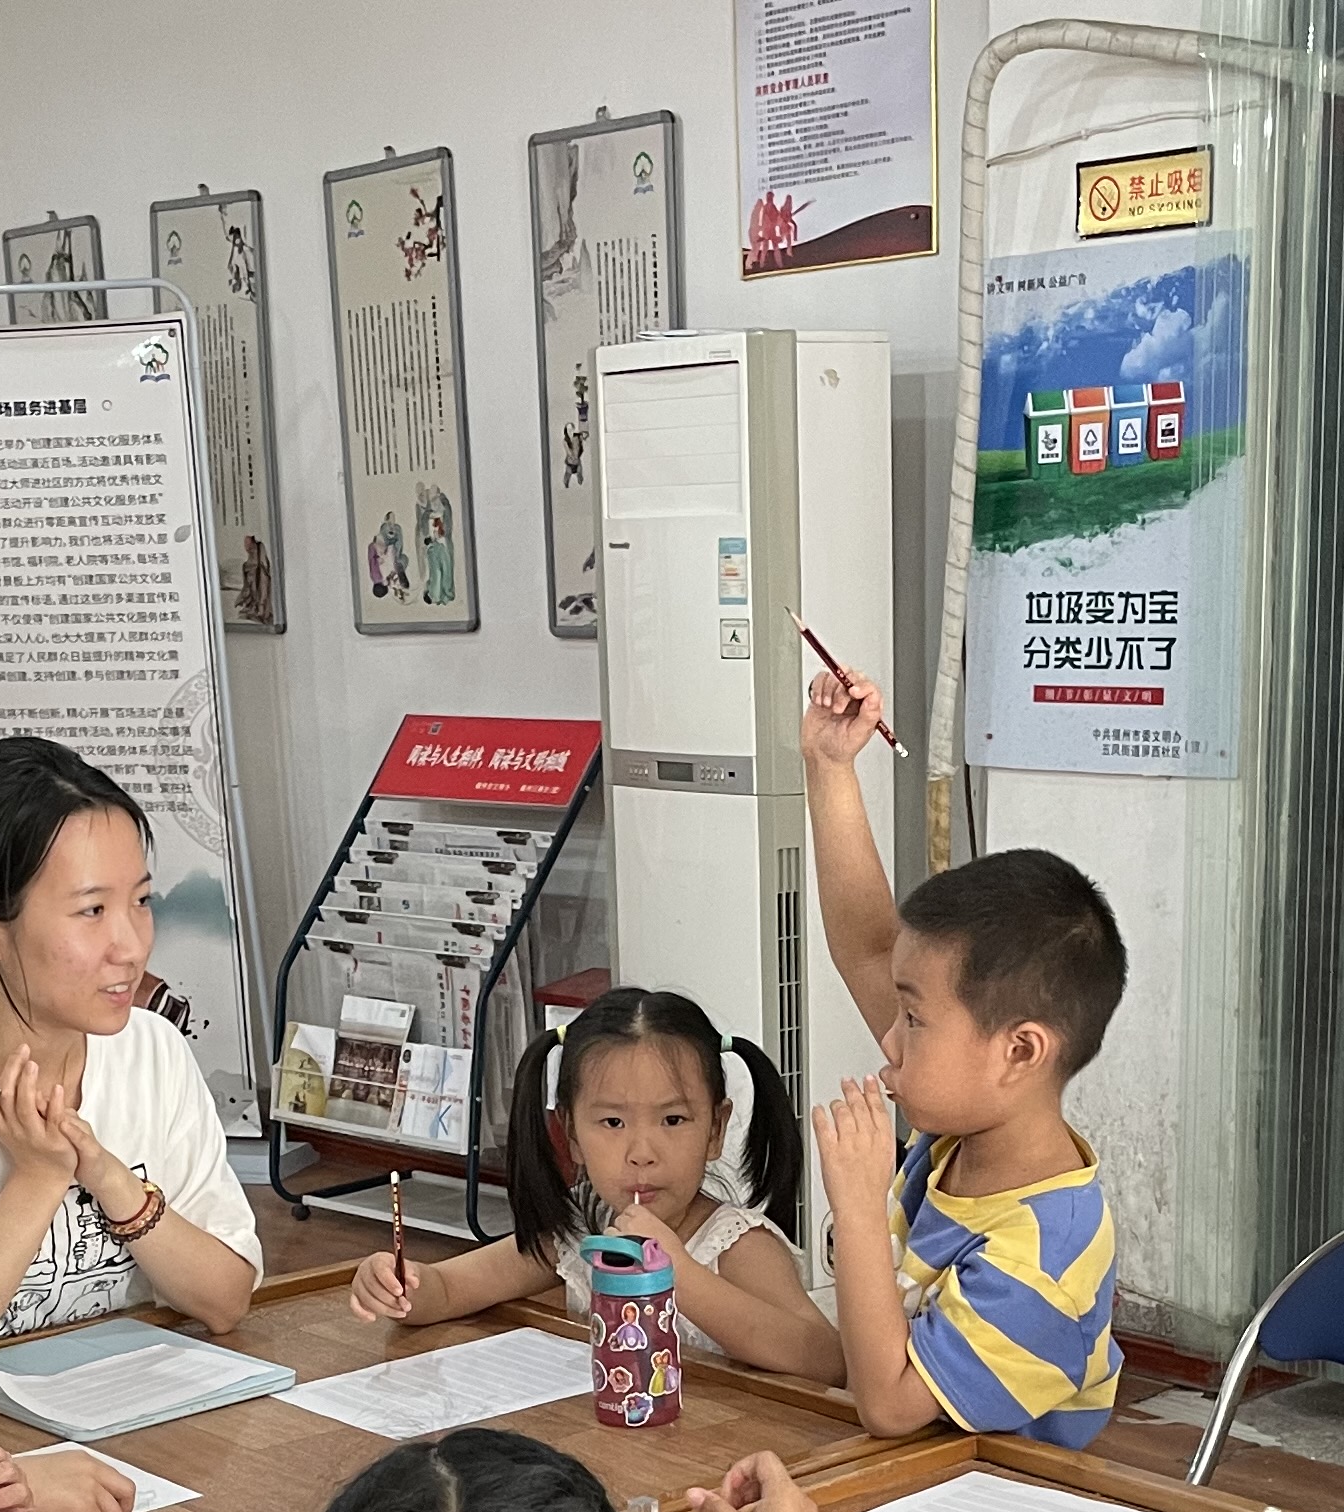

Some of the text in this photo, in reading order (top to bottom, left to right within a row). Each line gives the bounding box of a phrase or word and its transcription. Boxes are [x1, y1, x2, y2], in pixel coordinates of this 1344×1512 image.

[1128, 168, 1203, 201] 禁止吸烟
[1128, 206, 1144, 217] NO
[1025, 590, 1178, 624] 垃圾变为宝
[1023, 636, 1177, 670] 分类少不了
